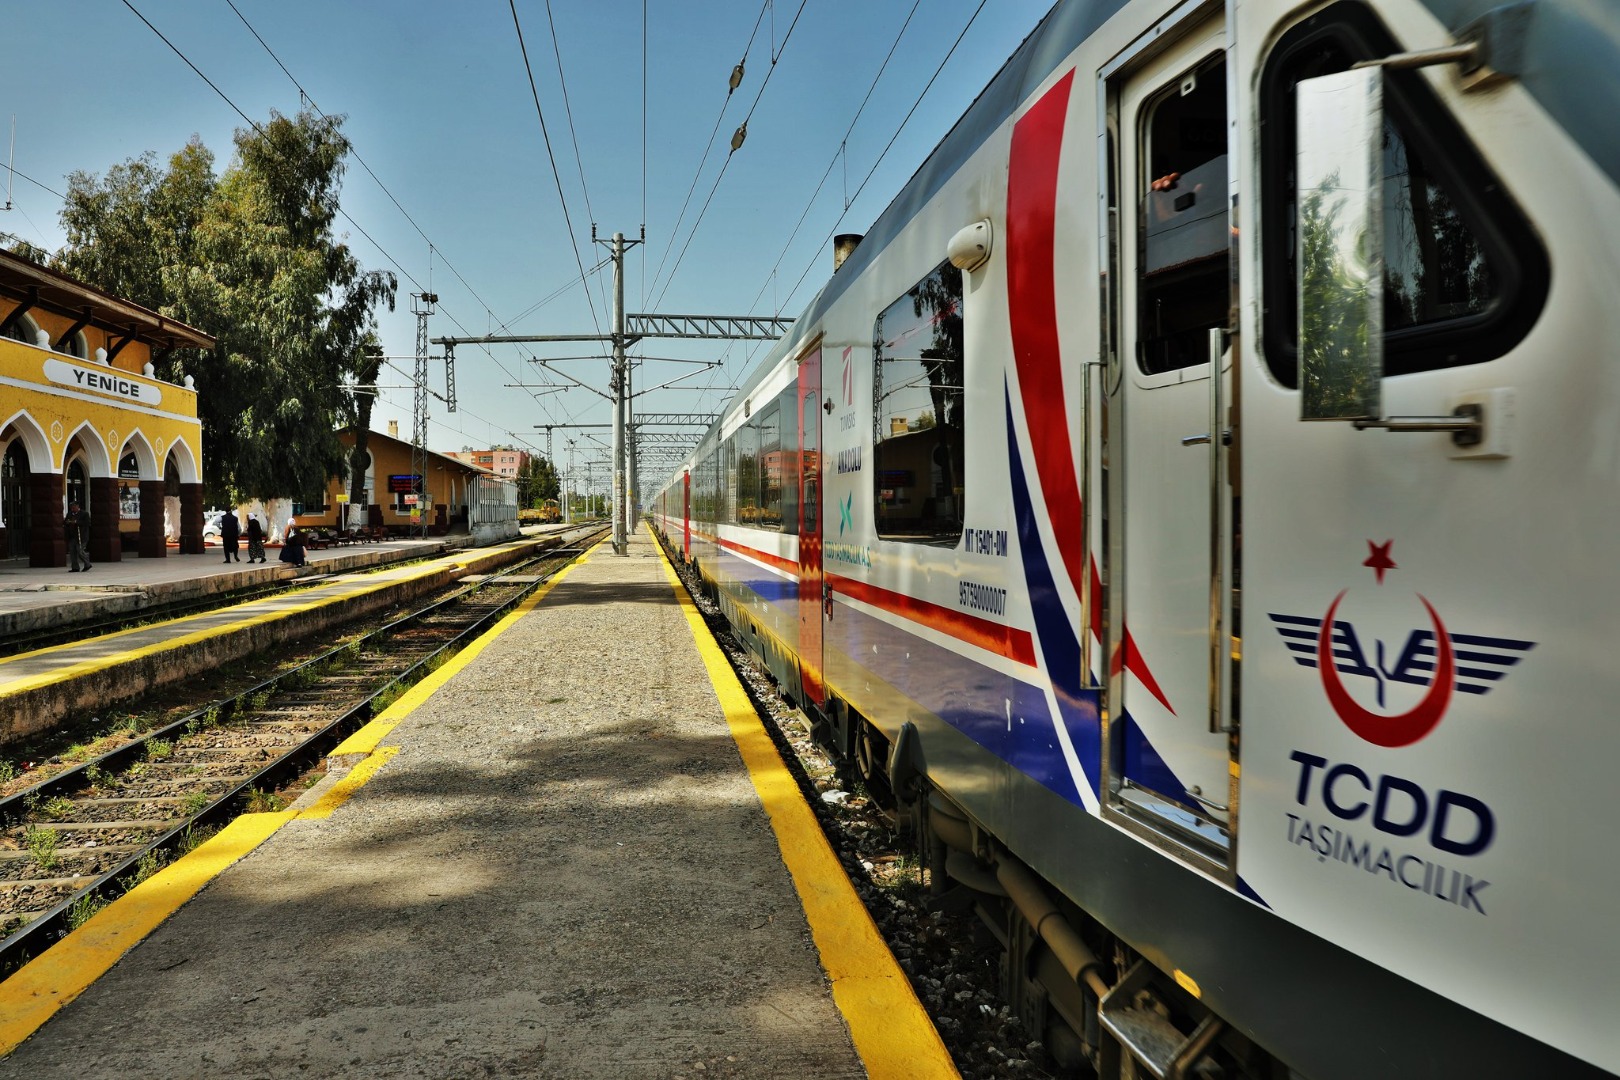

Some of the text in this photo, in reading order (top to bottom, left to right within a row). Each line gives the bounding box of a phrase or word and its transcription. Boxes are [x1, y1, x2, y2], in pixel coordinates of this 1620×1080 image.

[73, 369, 139, 397] YENİCE
[965, 528, 974, 552] MT
[1289, 749, 1496, 857] TCDD
[1285, 812, 1492, 916] TAŞIMACILIK
